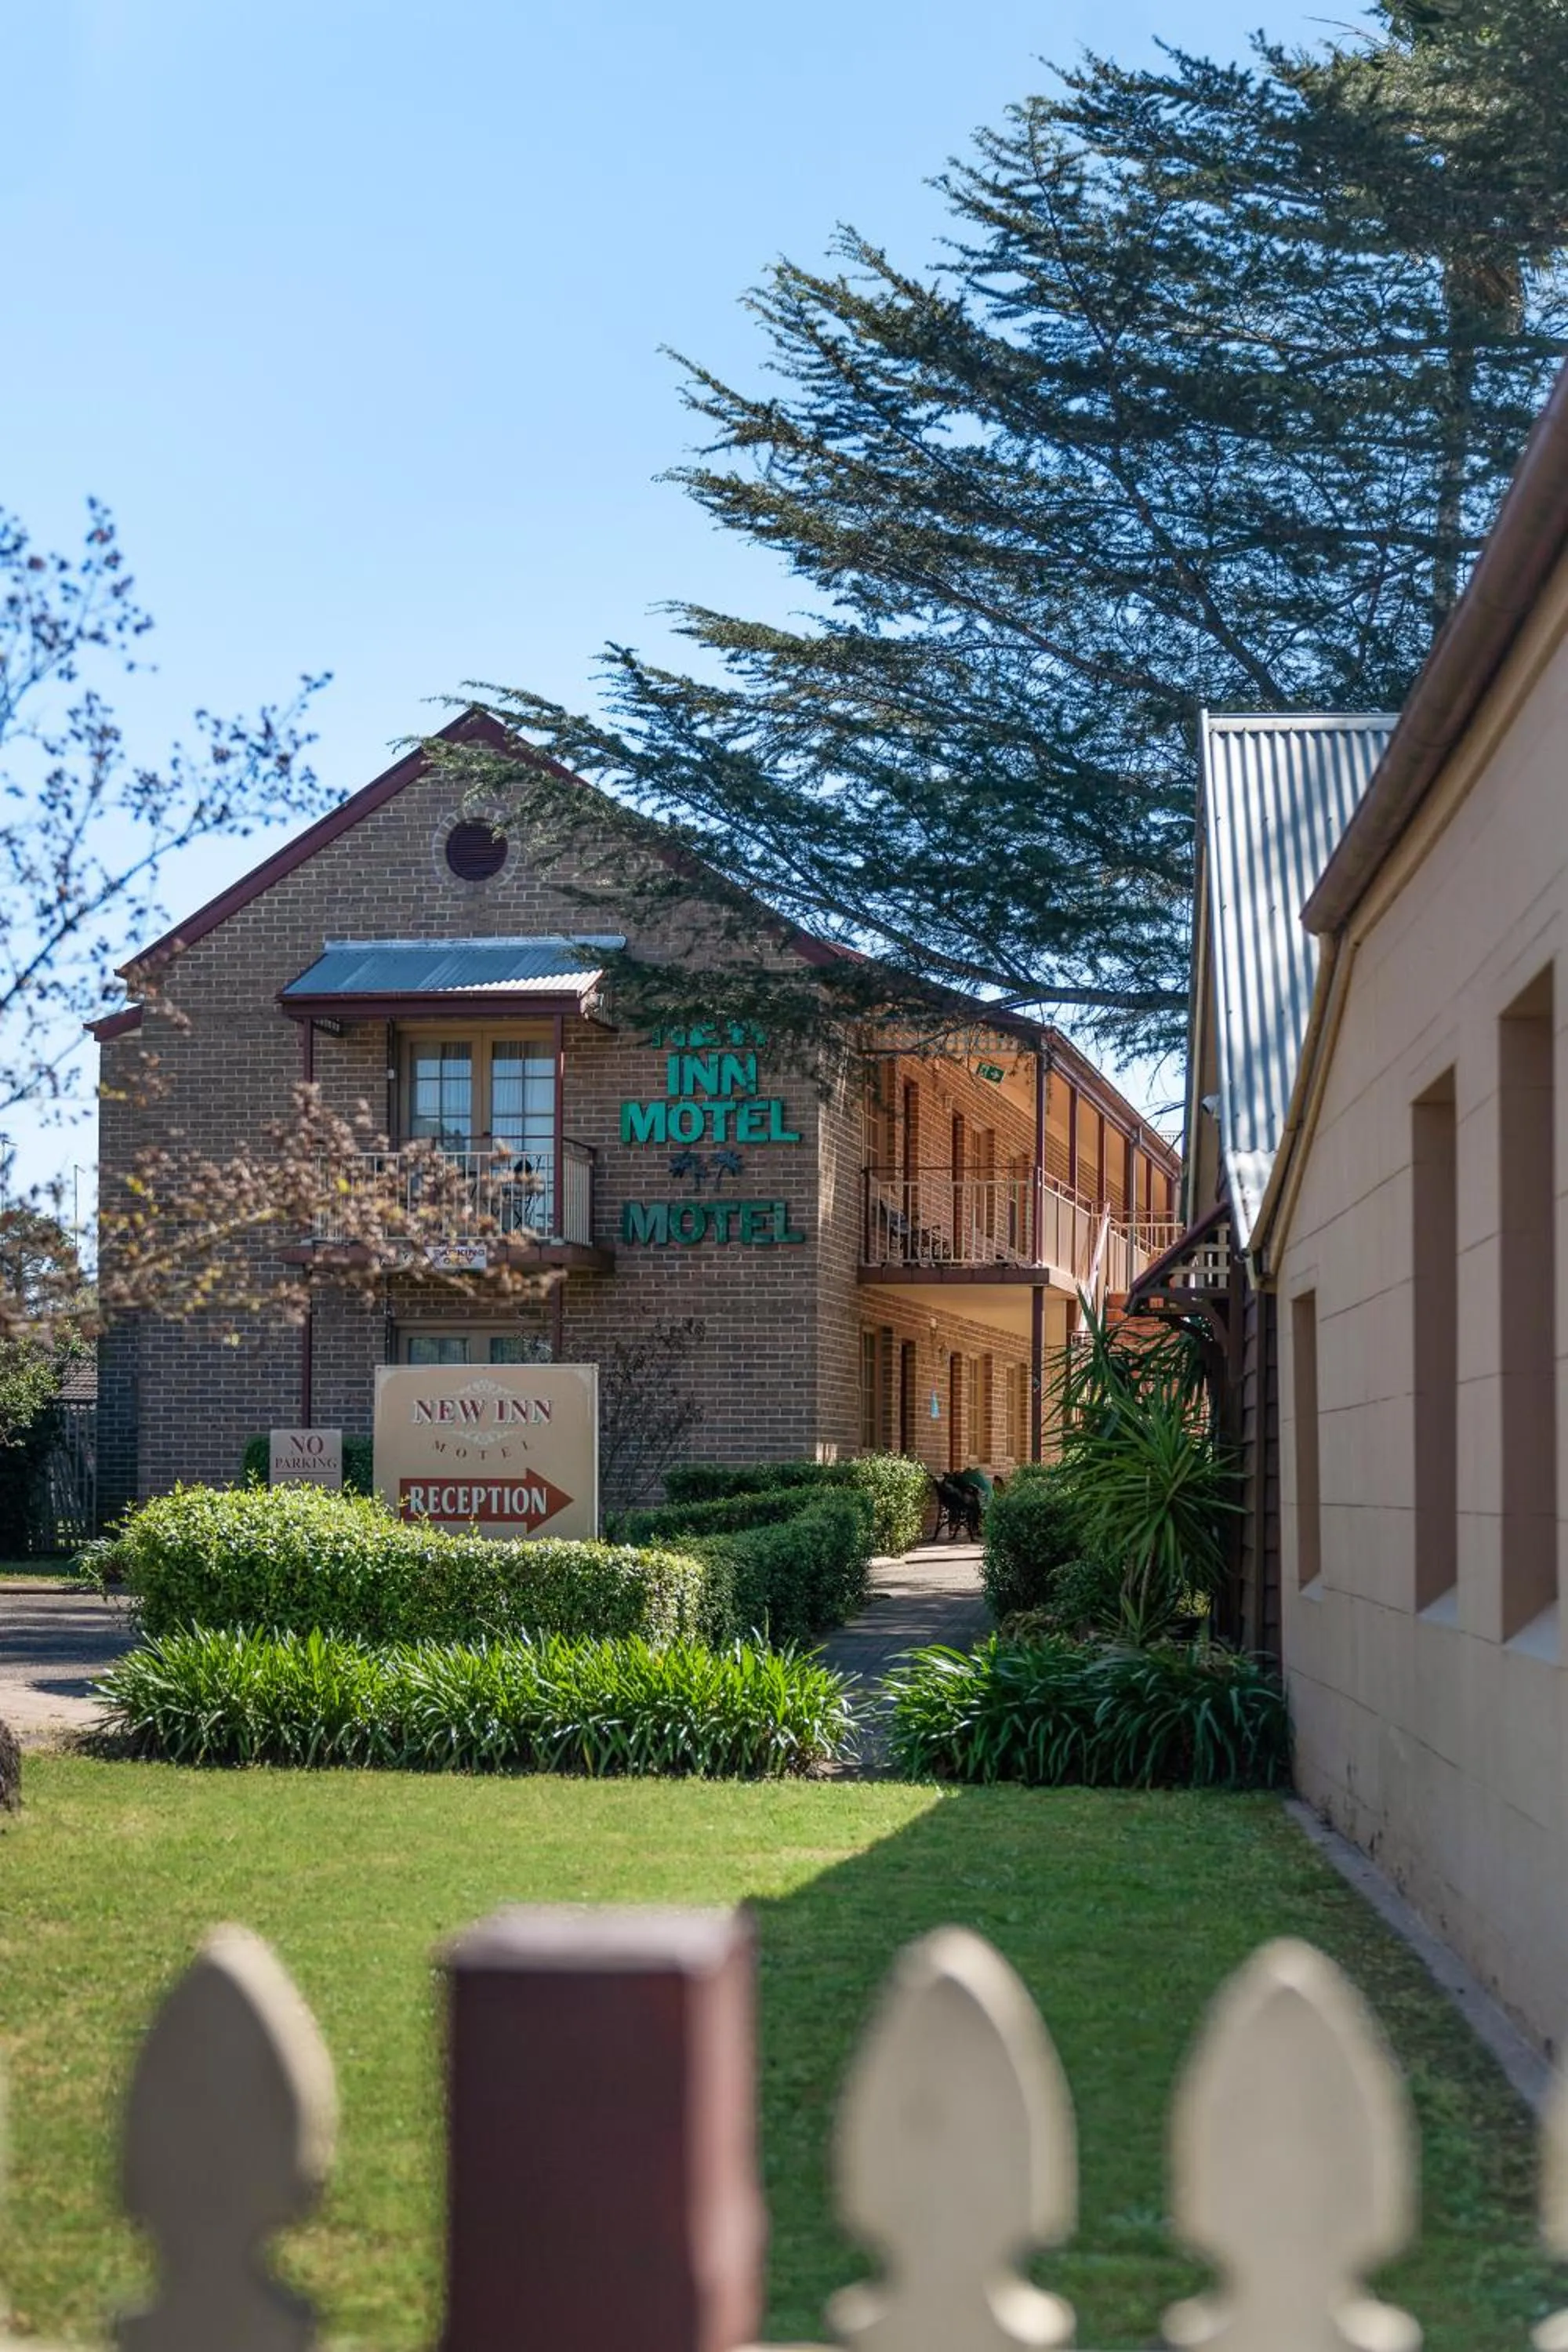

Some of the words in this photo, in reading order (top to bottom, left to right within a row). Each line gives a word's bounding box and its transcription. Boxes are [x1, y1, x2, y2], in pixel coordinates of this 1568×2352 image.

[667, 1052, 757, 1096] INN
[621, 1100, 801, 1144] MOTEL
[622, 1200, 805, 1244] MOTEL
[413, 1399, 485, 1424] NEW
[493, 1399, 552, 1424] INN
[290, 1435, 324, 1455] NO
[434, 1440, 534, 1461] MOTEL
[275, 1457, 337, 1468] PARKING
[409, 1486, 547, 1515] RECEPTION
